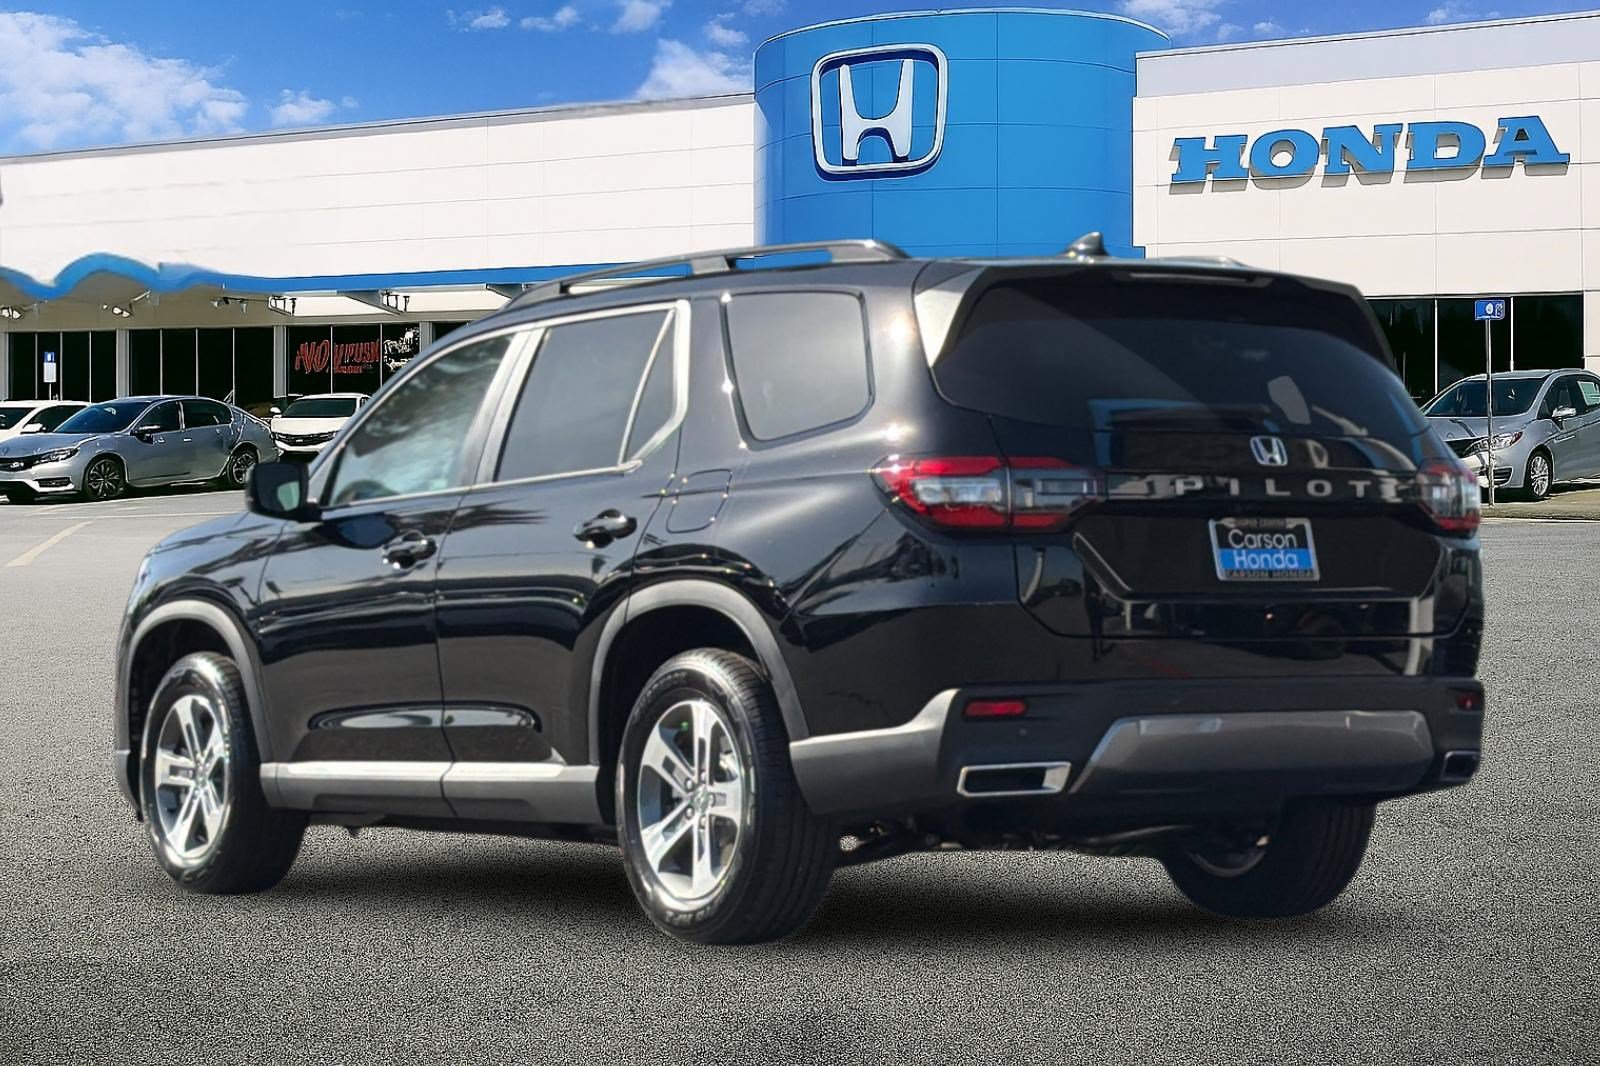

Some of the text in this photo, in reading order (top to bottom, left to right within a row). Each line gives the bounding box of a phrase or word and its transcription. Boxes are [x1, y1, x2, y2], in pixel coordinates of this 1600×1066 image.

[1170, 115, 1571, 187] HONDA
[1174, 478, 1372, 498] PILOT
[1228, 528, 1297, 549] Carson
[1233, 549, 1299, 569] Honda
